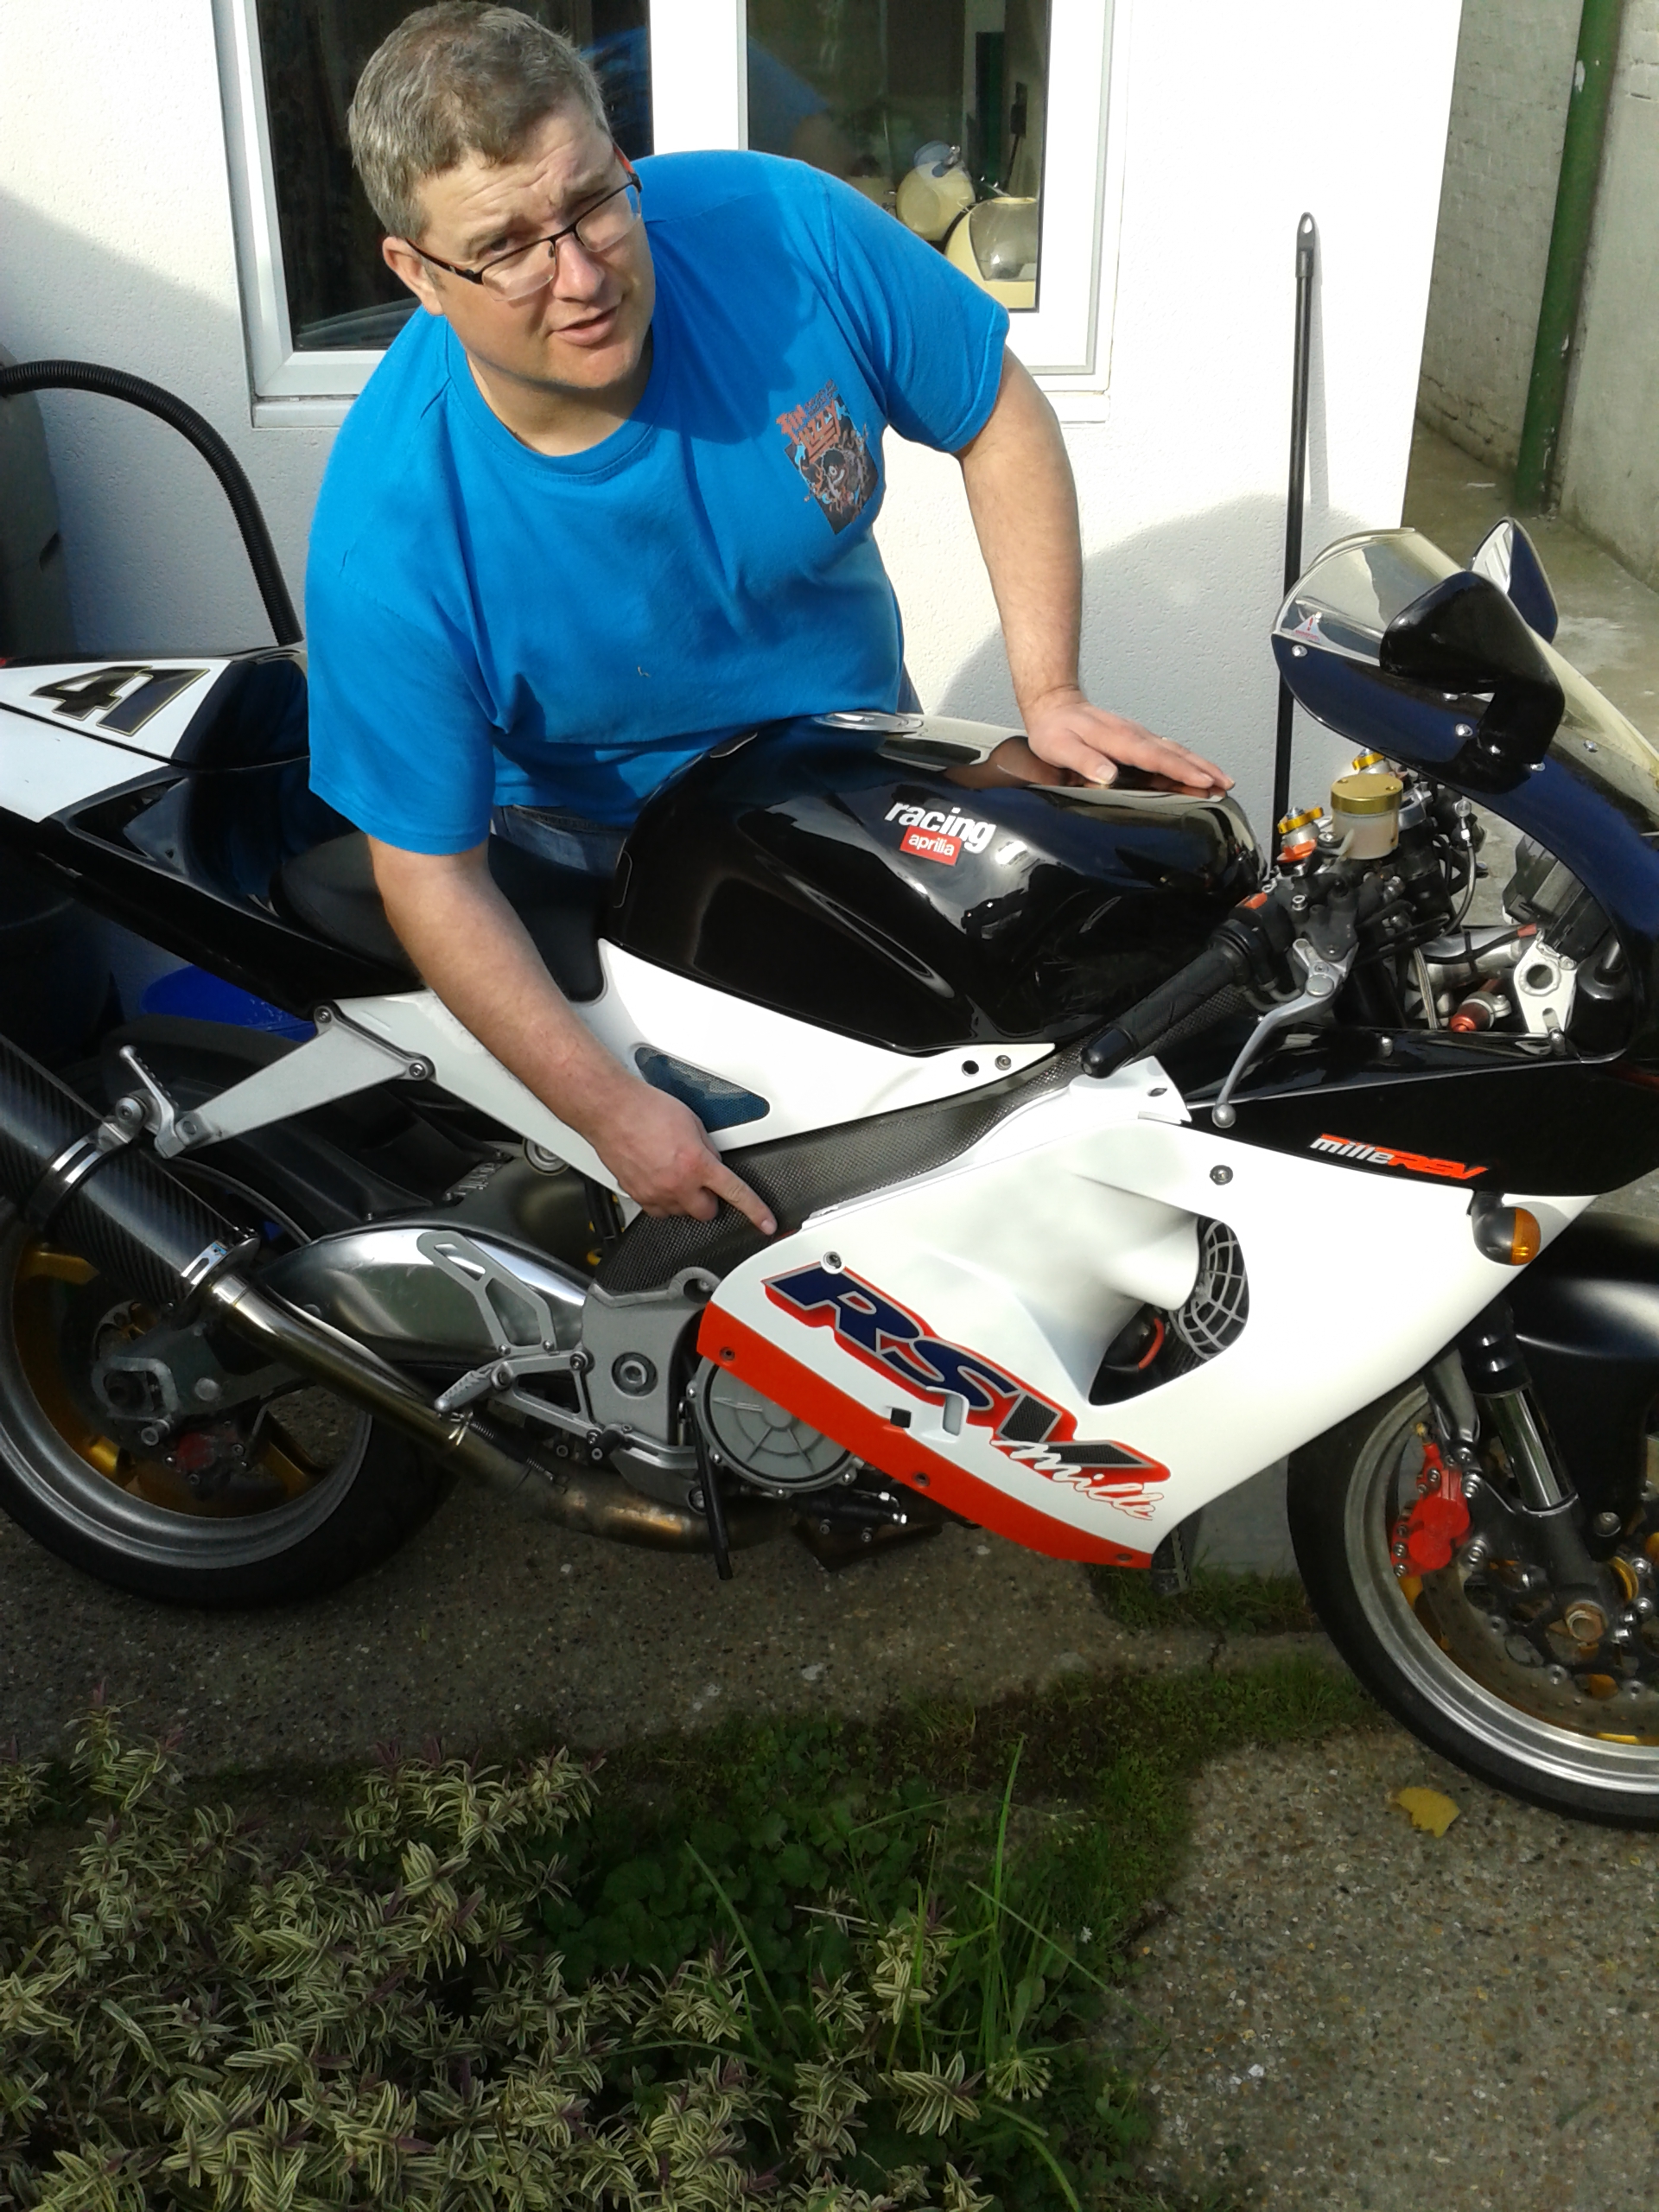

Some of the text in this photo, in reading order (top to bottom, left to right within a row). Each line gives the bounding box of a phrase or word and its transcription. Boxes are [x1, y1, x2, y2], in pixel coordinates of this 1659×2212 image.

[798, 398, 841, 464] LIZZY
[884, 802, 997, 854] racing
[908, 833, 955, 856] aprilia
[989, 1439, 1165, 1521] mille
